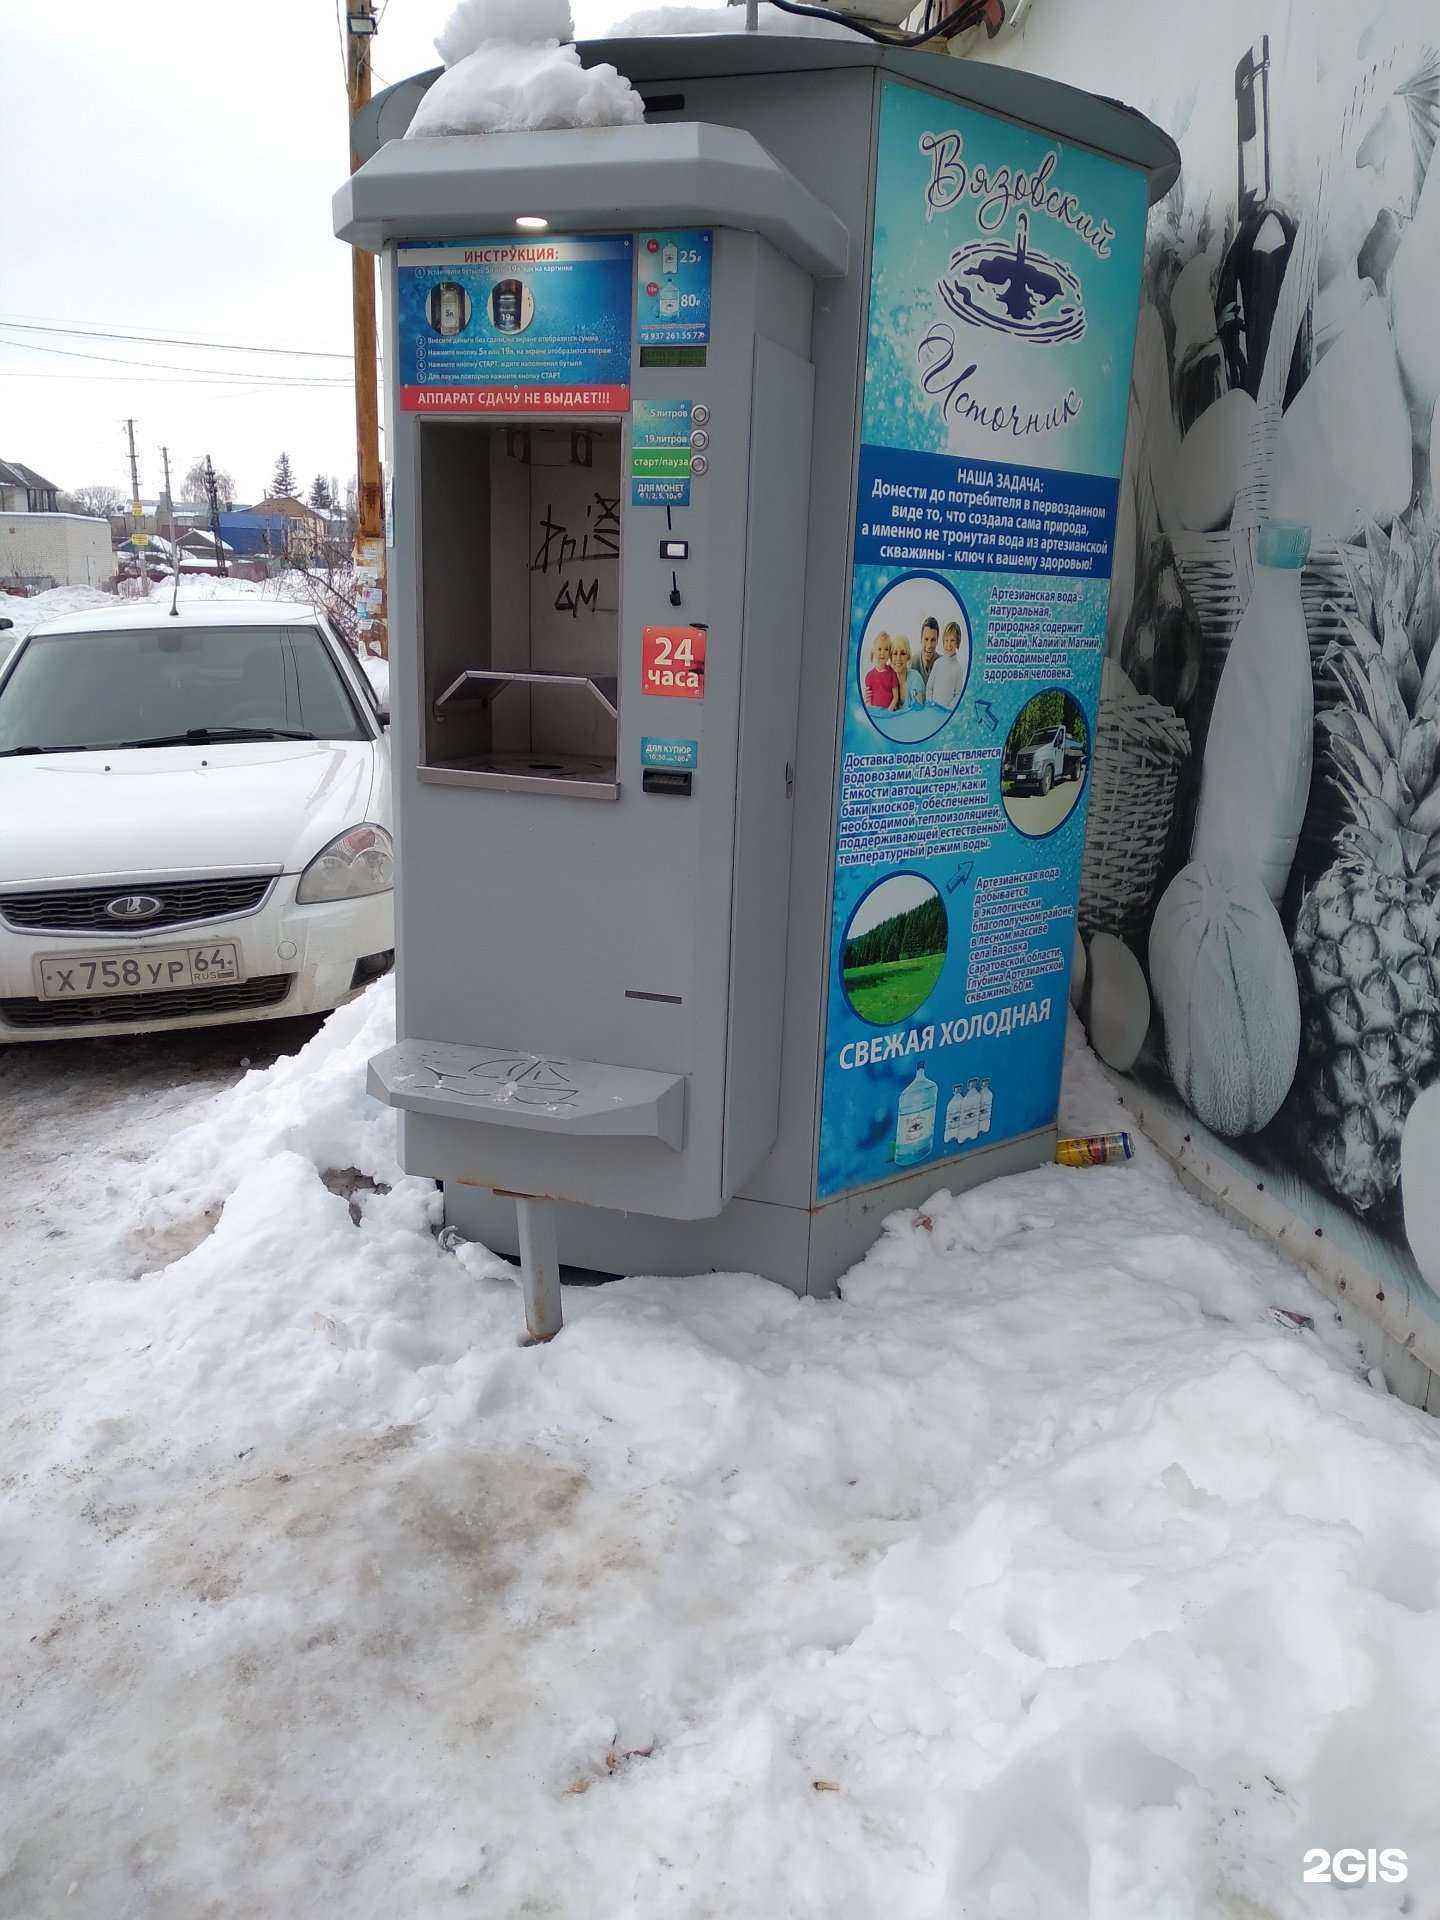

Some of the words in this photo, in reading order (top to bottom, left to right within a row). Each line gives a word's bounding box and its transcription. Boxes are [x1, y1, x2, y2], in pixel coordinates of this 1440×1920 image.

[920, 130, 1116, 258] Вязовский
[464, 247, 559, 263] ИНСТРУКЦИЯ:
[917, 323, 1082, 436] Источник
[418, 391, 474, 405] АППАРАТ
[479, 391, 520, 406] СДАЧУ
[525, 392, 540, 403] НЕ
[544, 391, 610, 406] ВЫДАЕТ!!!
[657, 409, 688, 419] литров
[656, 435, 688, 446] литров
[634, 456, 689, 468] старт/пауза
[638, 484, 654, 493] ДЛЯ
[656, 484, 684, 492] МОНЕТ
[957, 467, 994, 487] НАША
[996, 472, 1044, 493] ЗАДАЧА:
[872, 478, 927, 499] Донести
[929, 488, 945, 501] до
[948, 489, 1022, 511] потребителя
[1023, 500, 1031, 510] в
[1032, 500, 1106, 519] первозданном
[891, 504, 923, 520] виде
[925, 507, 944, 523] то,
[946, 510, 966, 523] что
[968, 513, 1014, 528] создала
[1016, 517, 1041, 531] сама
[1043, 520, 1089, 536] природа,
[861, 523, 869, 535] а
[872, 523, 922, 540] именно
[925, 527, 940, 541] не
[942, 529, 996, 547] тронутая
[998, 534, 1024, 548] вода
[1027, 537, 1039, 549] из
[1040, 538, 1108, 555] артезианской
[880, 544, 945, 562] скважины
[954, 549, 985, 564] ключ
[987, 552, 993, 564] к
[996, 554, 1038, 570] вашему
[1040, 556, 1093, 571] здоровью!
[991, 586, 1055, 602] Артезианская
[1057, 591, 1077, 603] вода
[990, 605, 1052, 619] натуральная,
[988, 621, 1040, 634] природная
[1041, 623, 1084, 634] содержит
[654, 636, 694, 667] 24
[987, 635, 1030, 650] Кальций,
[1032, 635, 1059, 649] Калий
[1068, 636, 1102, 651] Магний,
[985, 652, 1050, 665] необходимые
[1051, 653, 1067, 665] для
[648, 669, 699, 689] часа
[984, 669, 1029, 682] здоровья
[1030, 668, 1074, 680] человека.
[664, 745, 692, 755] КУПЮР
[845, 753, 894, 769] Доставка
[896, 752, 924, 766] воды
[925, 748, 1002, 764] осуществляется
[844, 770, 912, 786] водовозами
[914, 766, 951, 778] «ГАЗон
[843, 785, 889, 801] Емкости
[891, 781, 960, 797] автоцистерн,
[961, 780, 978, 791] как
[979, 779, 987, 788] и
[841, 803, 868, 817] баки
[871, 800, 918, 815] киосков,
[922, 795, 989, 811] обеспеченны
[841, 816, 916, 834] необходимой
[917, 807, 1001, 826] теплоизоляцией,
[839, 827, 938, 850] поддерживающей
[940, 820, 1007, 837] естественный
[839, 846, 925, 866] температурный
[926, 841, 961, 856] режим
[963, 839, 991, 852] воды.
[976, 870, 1038, 890] Артезианская
[1040, 867, 1060, 881] вода
[975, 887, 1029, 906] добывается
[974, 909, 980, 919] в
[981, 898, 1041, 916] экологически
[972, 912, 1041, 933] благополучном
[1042, 906, 1074, 919] районе
[971, 938, 978, 948] в
[979, 929, 1013, 944] лесном
[1013, 924, 1048, 939] массиве
[970, 949, 990, 961] села
[992, 942, 1028, 957] Вязовка
[56, 959, 184, 992] Х758УР
[194, 949, 226, 972] 64
[968, 956, 1026, 975] Саратовской
[968, 973, 1004, 991] Глубина
[1005, 959, 1064, 979] Артезианской
[194, 972, 217, 981] RUS
[966, 986, 1012, 1003] скважины
[1013, 980, 1024, 992] 60
[839, 1025, 935, 1070] СВЕЖАЯ
[939, 998, 1052, 1047] ХОЛОДНАЯ
